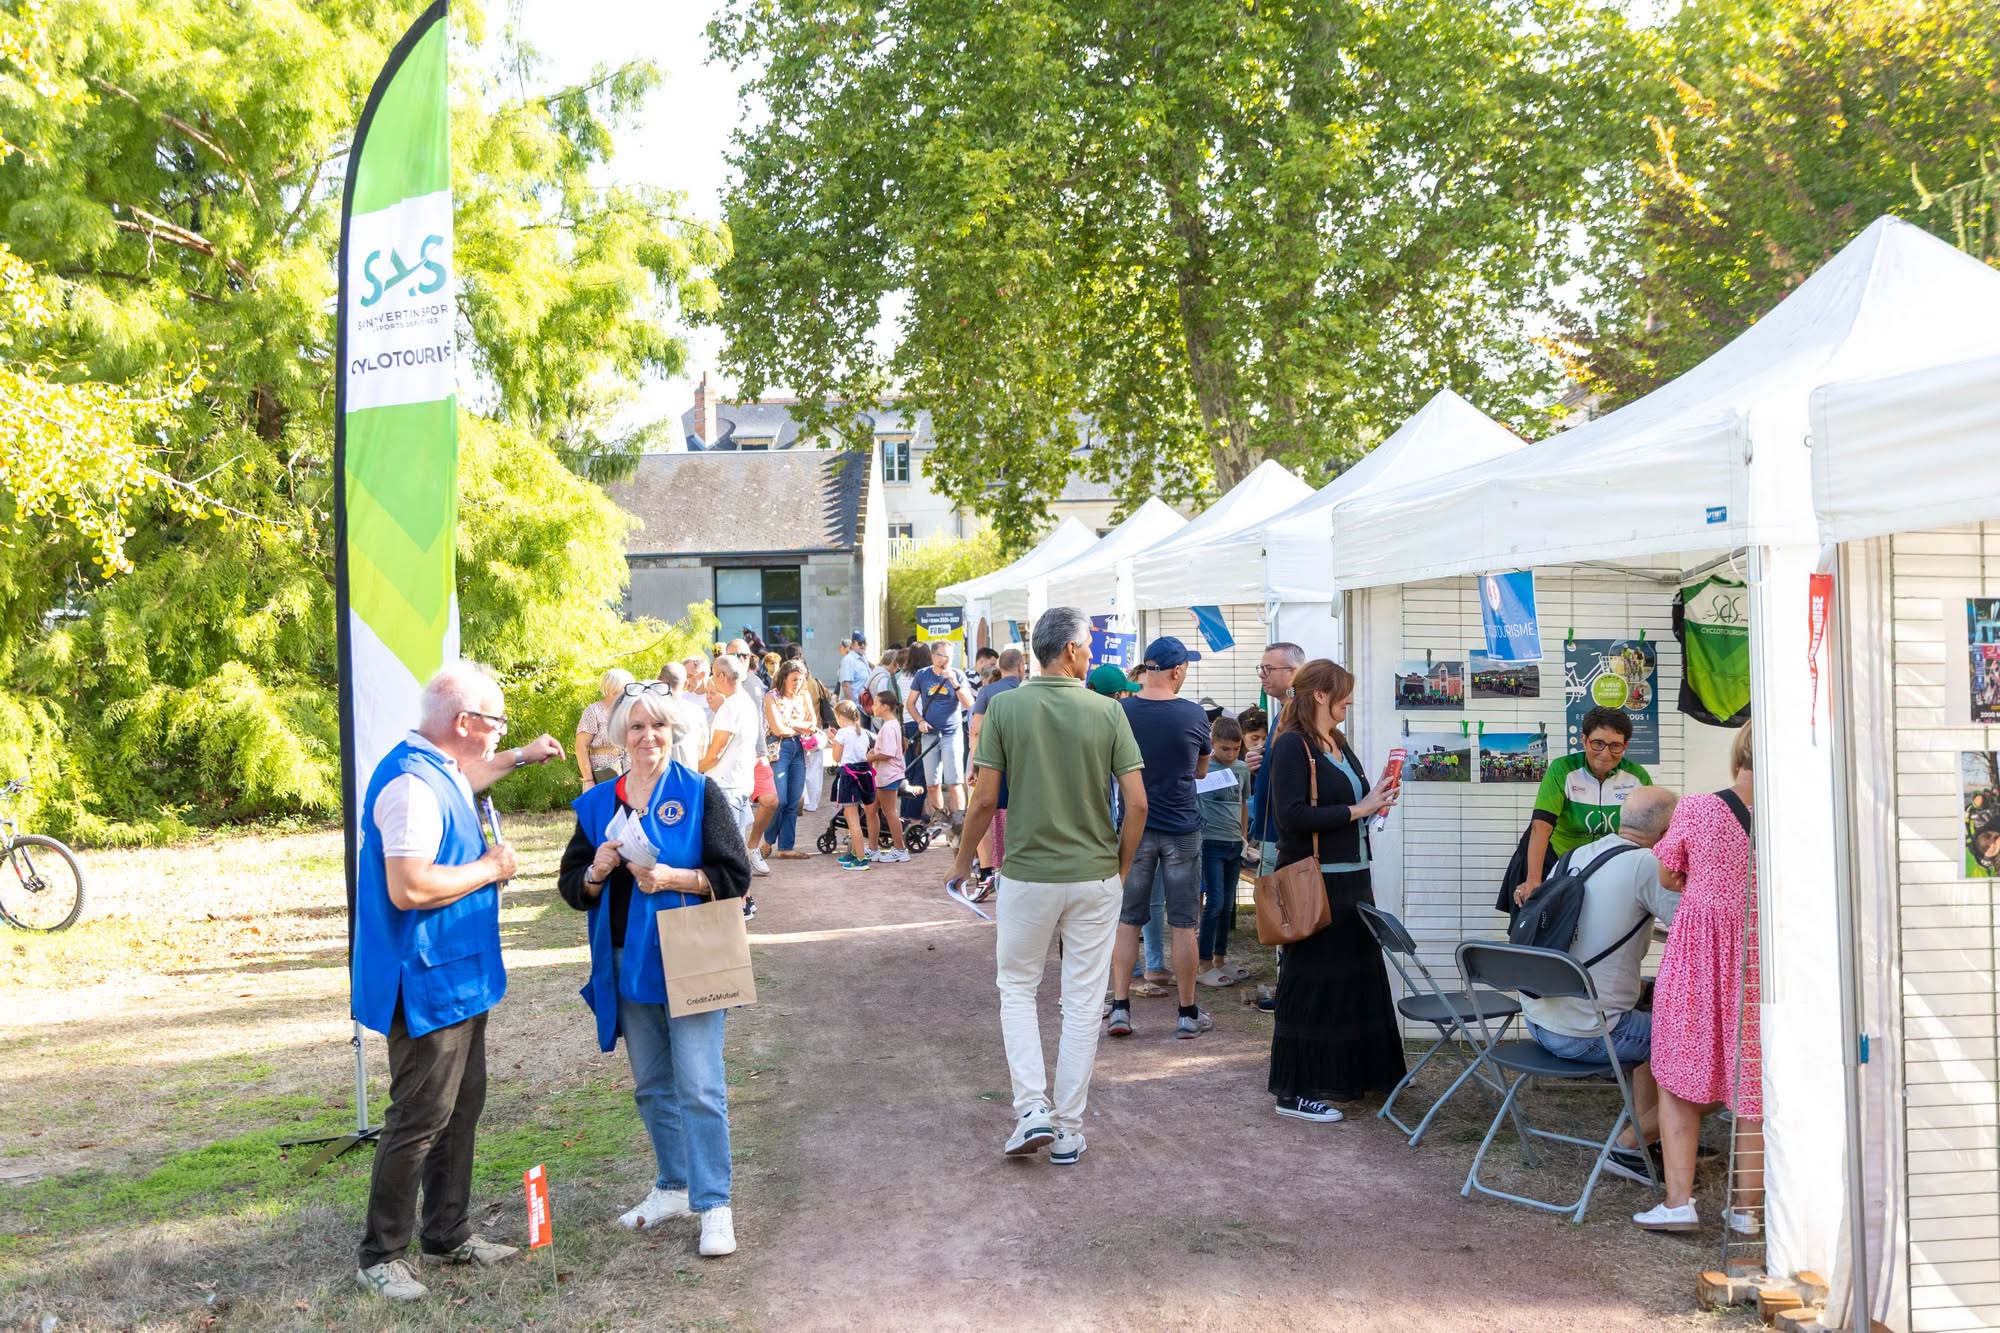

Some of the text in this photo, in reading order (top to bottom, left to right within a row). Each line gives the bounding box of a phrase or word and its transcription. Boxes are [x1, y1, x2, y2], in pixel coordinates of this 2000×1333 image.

[938, 626, 949, 634] Bleu
[667, 807, 675, 818] L
[686, 990, 740, 1006] Crédit Mutuel
